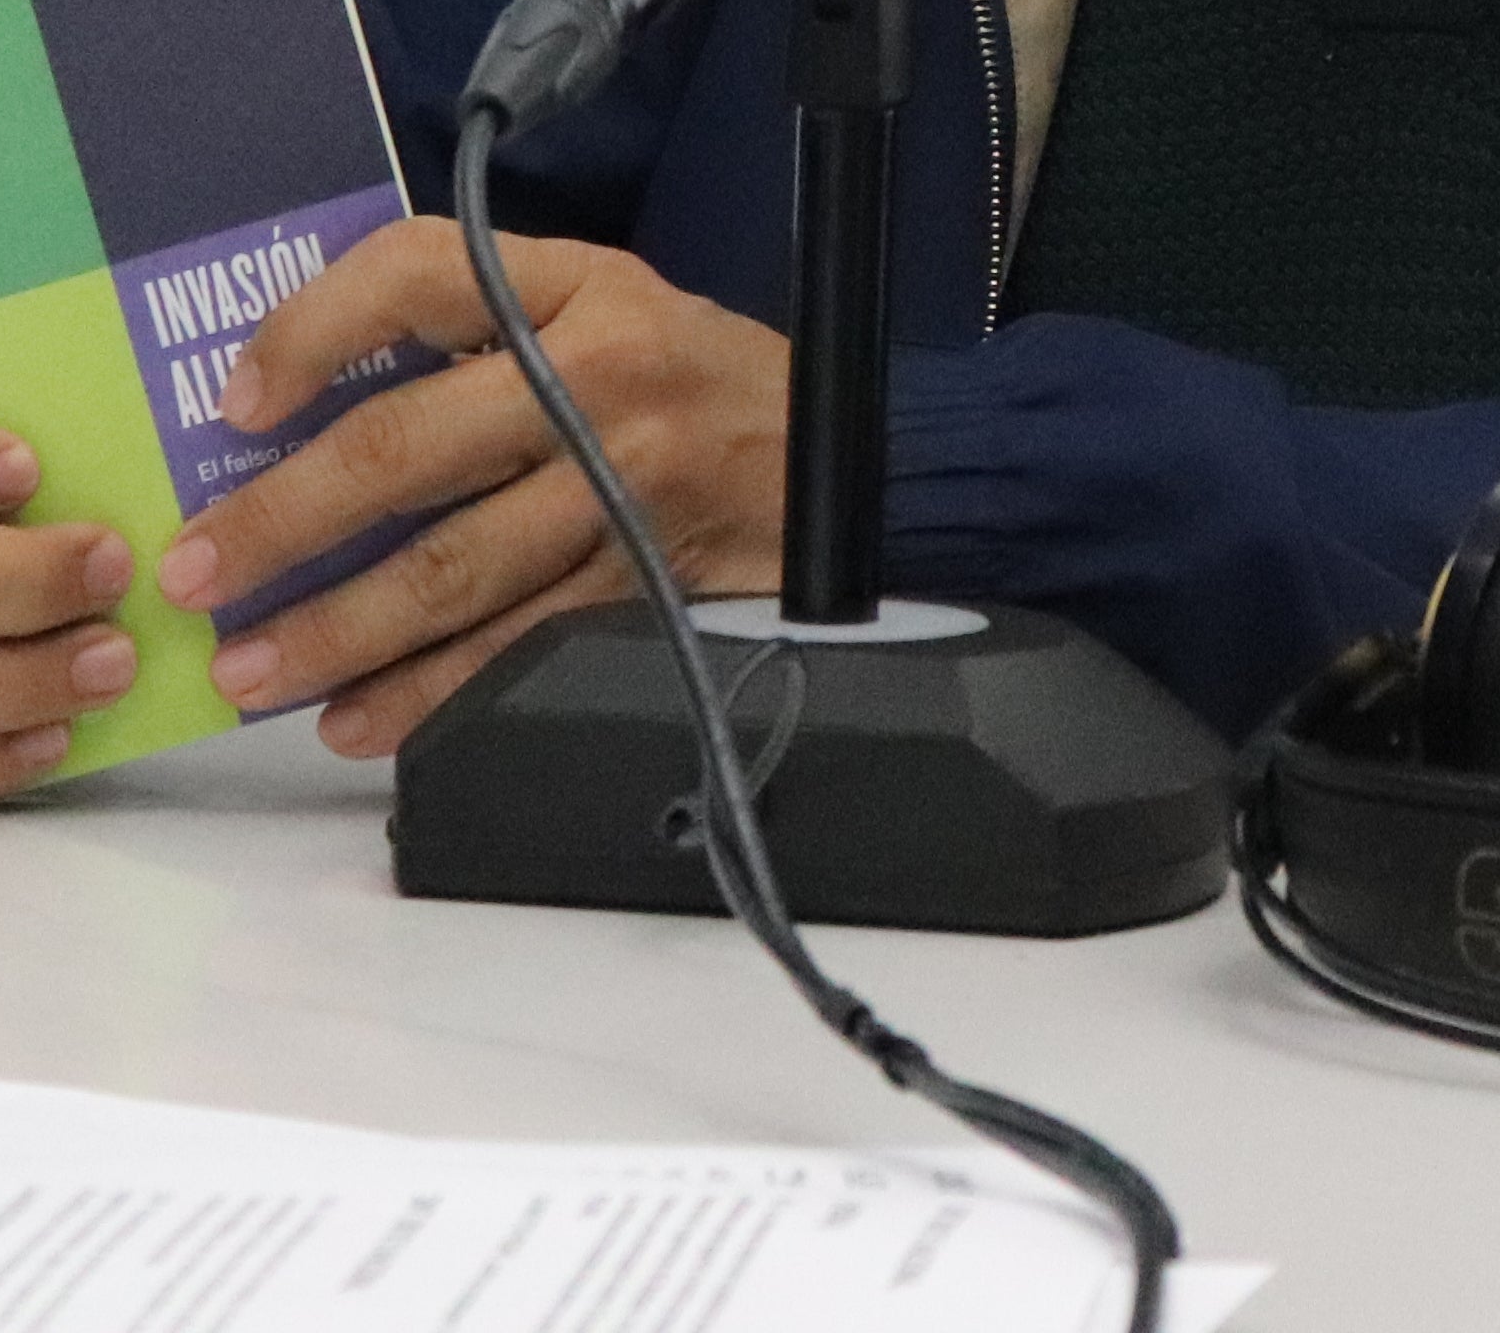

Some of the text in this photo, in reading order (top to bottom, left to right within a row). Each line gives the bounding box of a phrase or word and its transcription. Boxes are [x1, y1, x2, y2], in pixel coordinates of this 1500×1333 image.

[144, 225, 326, 349] INVASIÓN
[197, 460, 219, 483] El
[224, 448, 281, 474] falso
